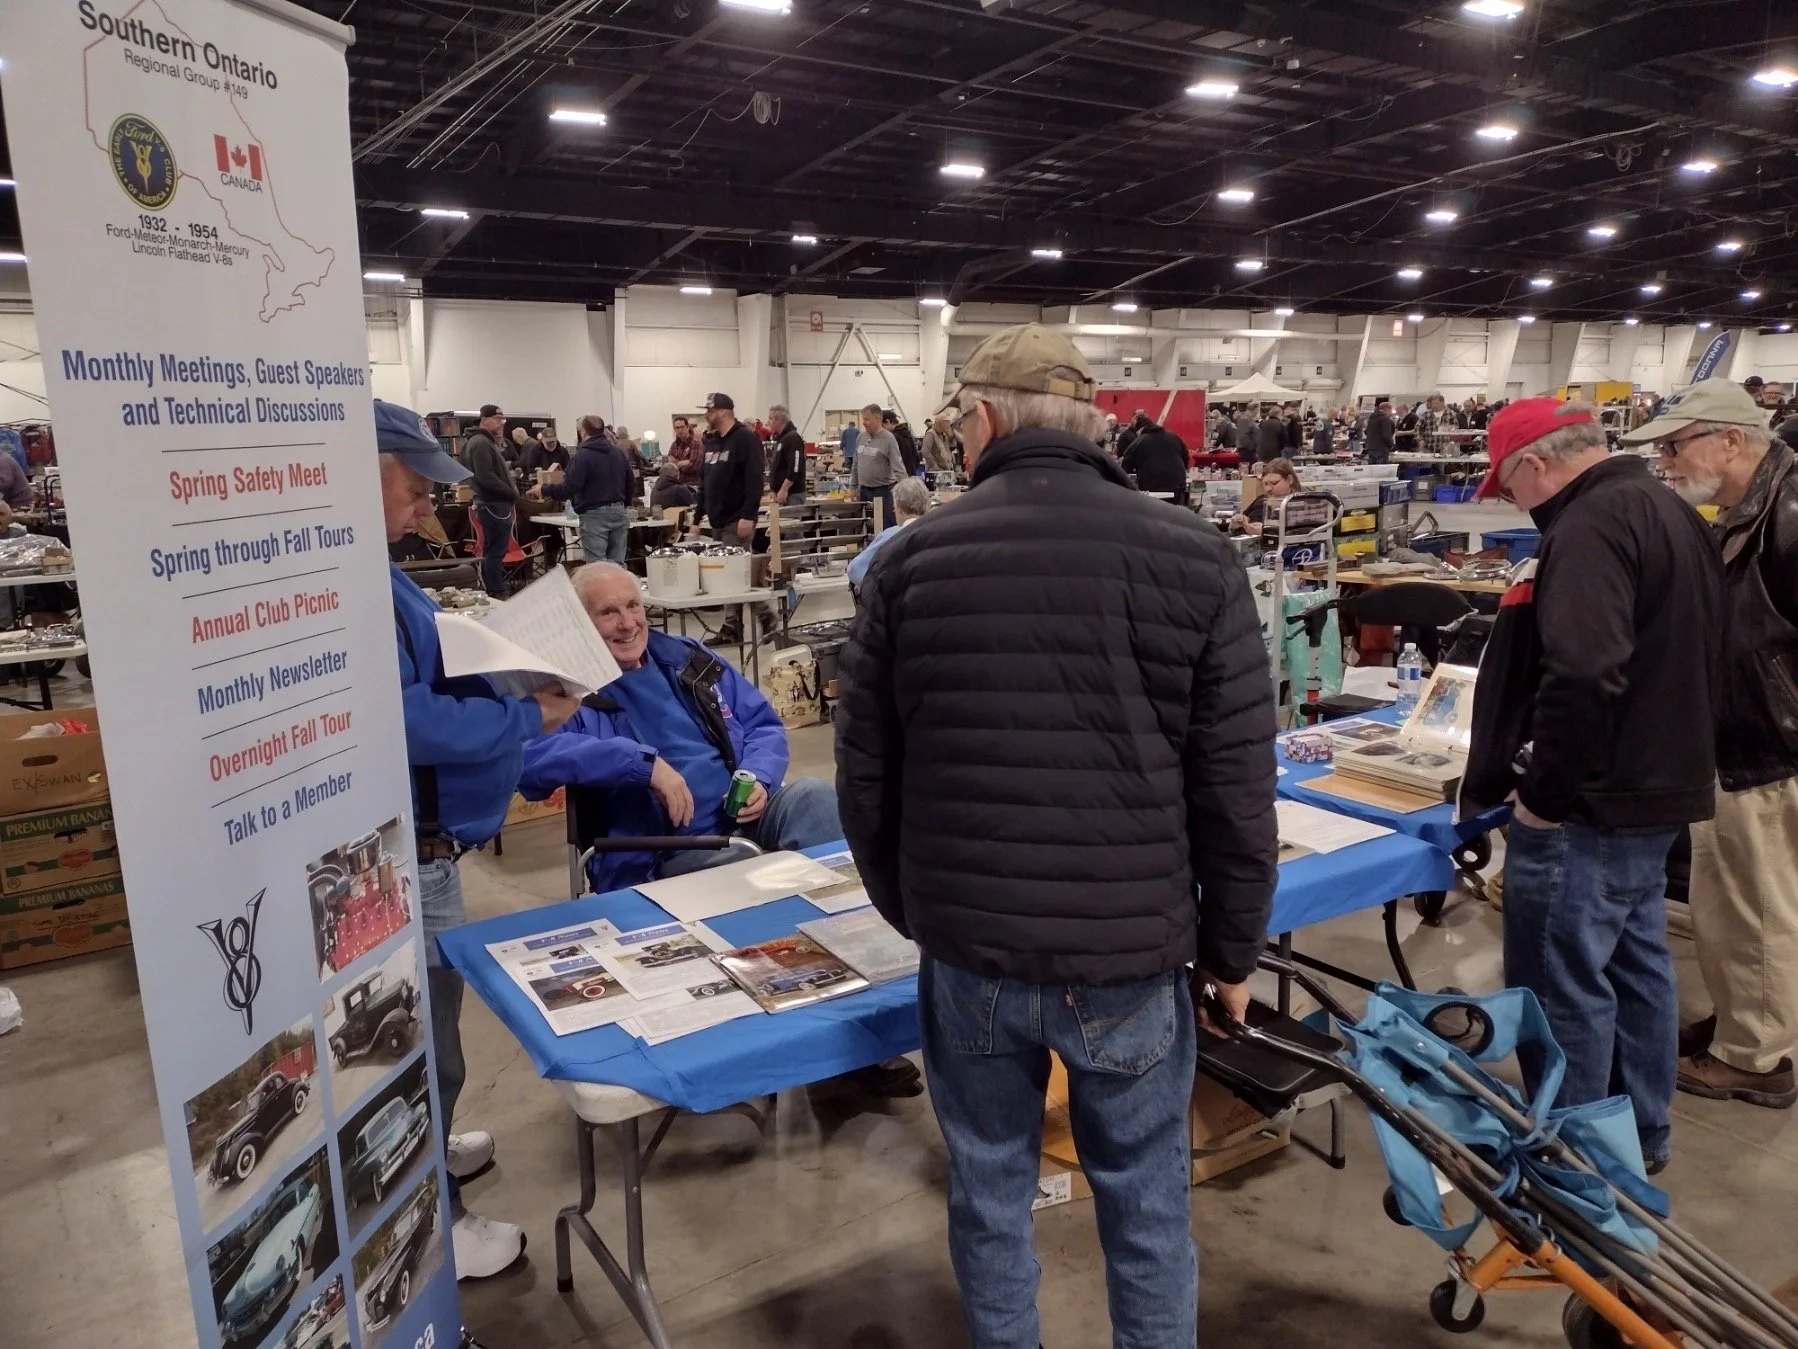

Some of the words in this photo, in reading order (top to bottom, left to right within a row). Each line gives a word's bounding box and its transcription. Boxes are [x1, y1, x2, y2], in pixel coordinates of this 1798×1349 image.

[79, 0, 196, 63] Southern
[203, 42, 278, 90] Ontario
[124, 48, 181, 79] Regional
[184, 67, 220, 92] Group
[223, 80, 248, 100] #149
[113, 127, 125, 155] EARLY
[125, 121, 156, 143] Ford
[115, 157, 125, 177] THE
[164, 158, 173, 186] CLUB
[128, 183, 138, 195] OF
[139, 190, 168, 204] AMERICA
[220, 173, 263, 194] CANADA
[106, 223, 250, 259] Ford-Meteor-Monarch-Mercury
[138, 213, 168, 233] 1932
[188, 222, 219, 240] 1954
[131, 240, 167, 258] Lincoln
[168, 246, 211, 264] Flathead
[212, 252, 233, 266] V-8s
[61, 349, 155, 389] Monthly
[160, 353, 252, 389] Meetings,
[255, 358, 300, 386] Guest
[305, 359, 365, 391] Speakers
[121, 397, 161, 427] and
[164, 396, 251, 425] Technical
[256, 397, 345, 424] Discussions
[169, 470, 229, 505] Spring
[233, 464, 284, 496] Safety
[288, 462, 328, 489] Meet
[150, 545, 211, 582] Spring
[215, 532, 281, 567] through
[284, 526, 312, 554] Fall
[315, 524, 355, 549] Tours
[192, 605, 251, 644] Annual
[255, 599, 290, 630] Club
[294, 588, 340, 619] Picnic
[198, 673, 264, 715] Monthly
[269, 650, 348, 690] Newsletter
[209, 731, 289, 783] Overnight
[291, 718, 318, 750] Fall
[320, 710, 352, 737] Tour
[224, 811, 258, 846] Talk
[262, 803, 277, 829] to
[282, 800, 291, 819] a
[295, 769, 353, 814] Member
[6, 816, 69, 837] PREMIUM
[19, 890, 67, 910] PREMIUM
[69, 881, 115, 900] BANANAS
